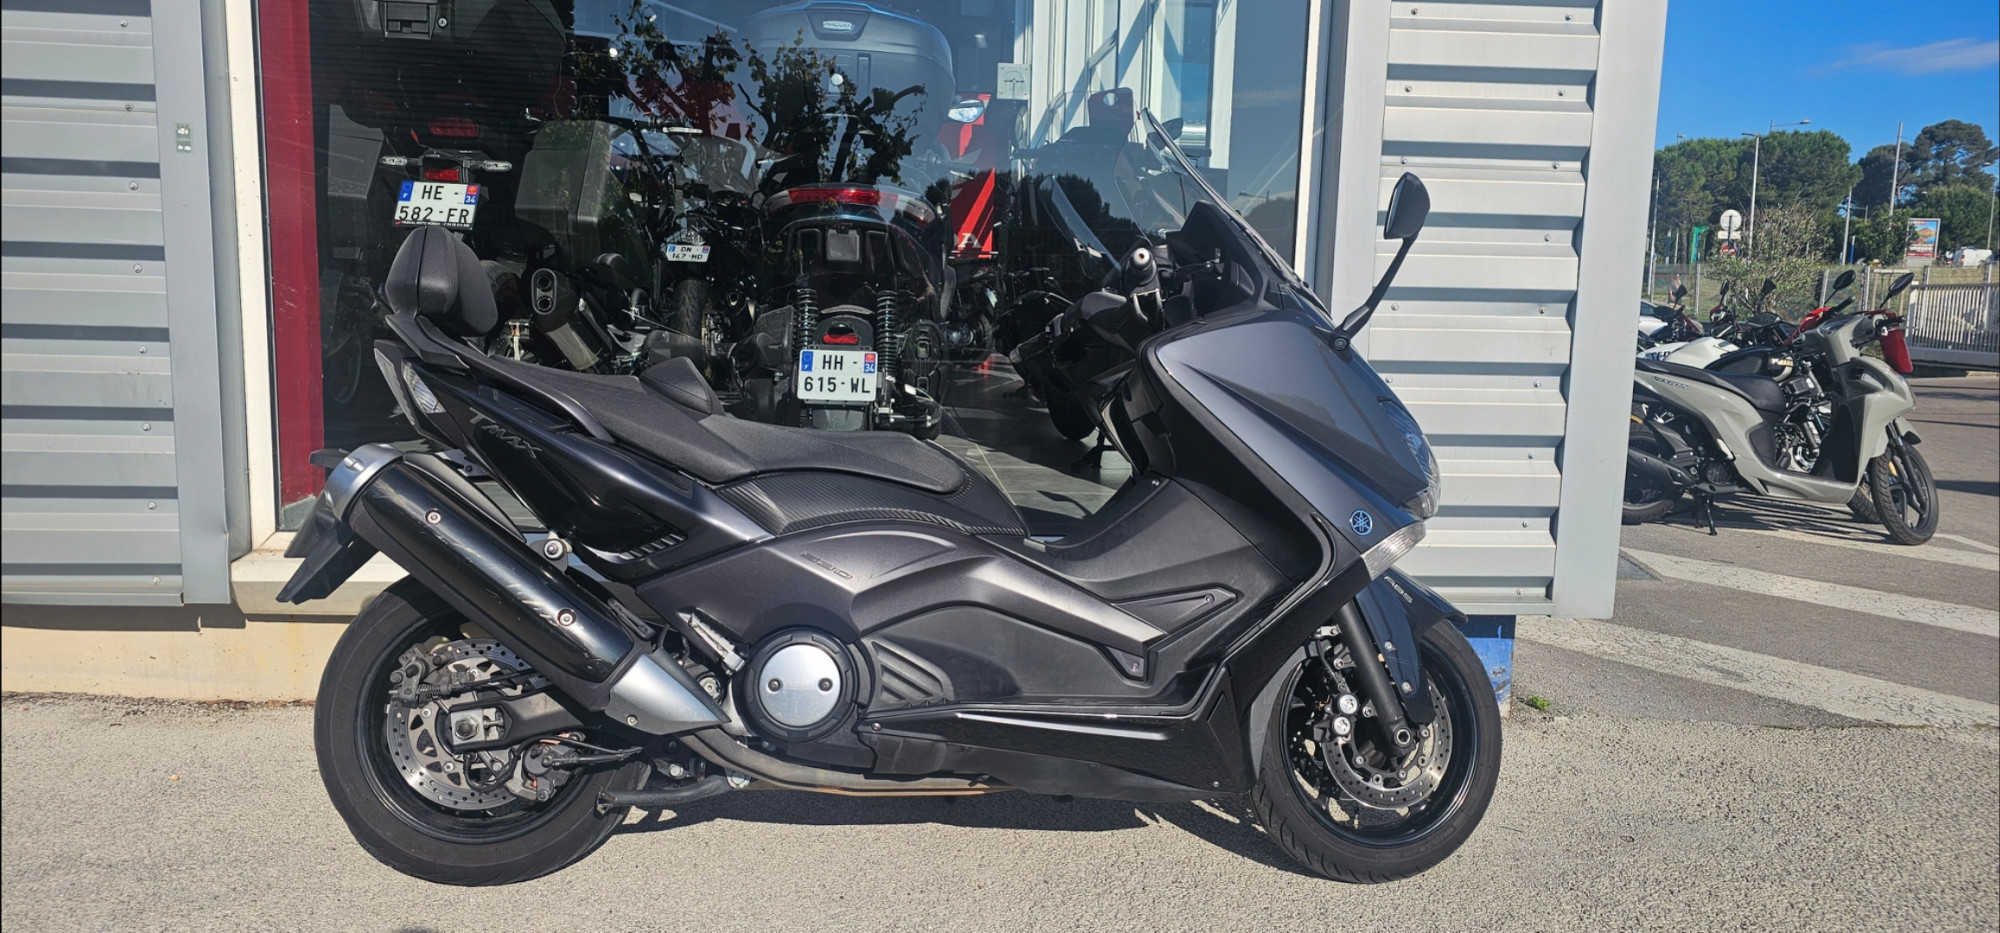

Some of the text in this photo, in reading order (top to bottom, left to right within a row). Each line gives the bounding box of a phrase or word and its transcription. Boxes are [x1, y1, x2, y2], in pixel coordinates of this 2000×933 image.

[421, 184, 445, 201] HE
[822, 354, 844, 371] HH
[864, 363, 875, 373] 34
